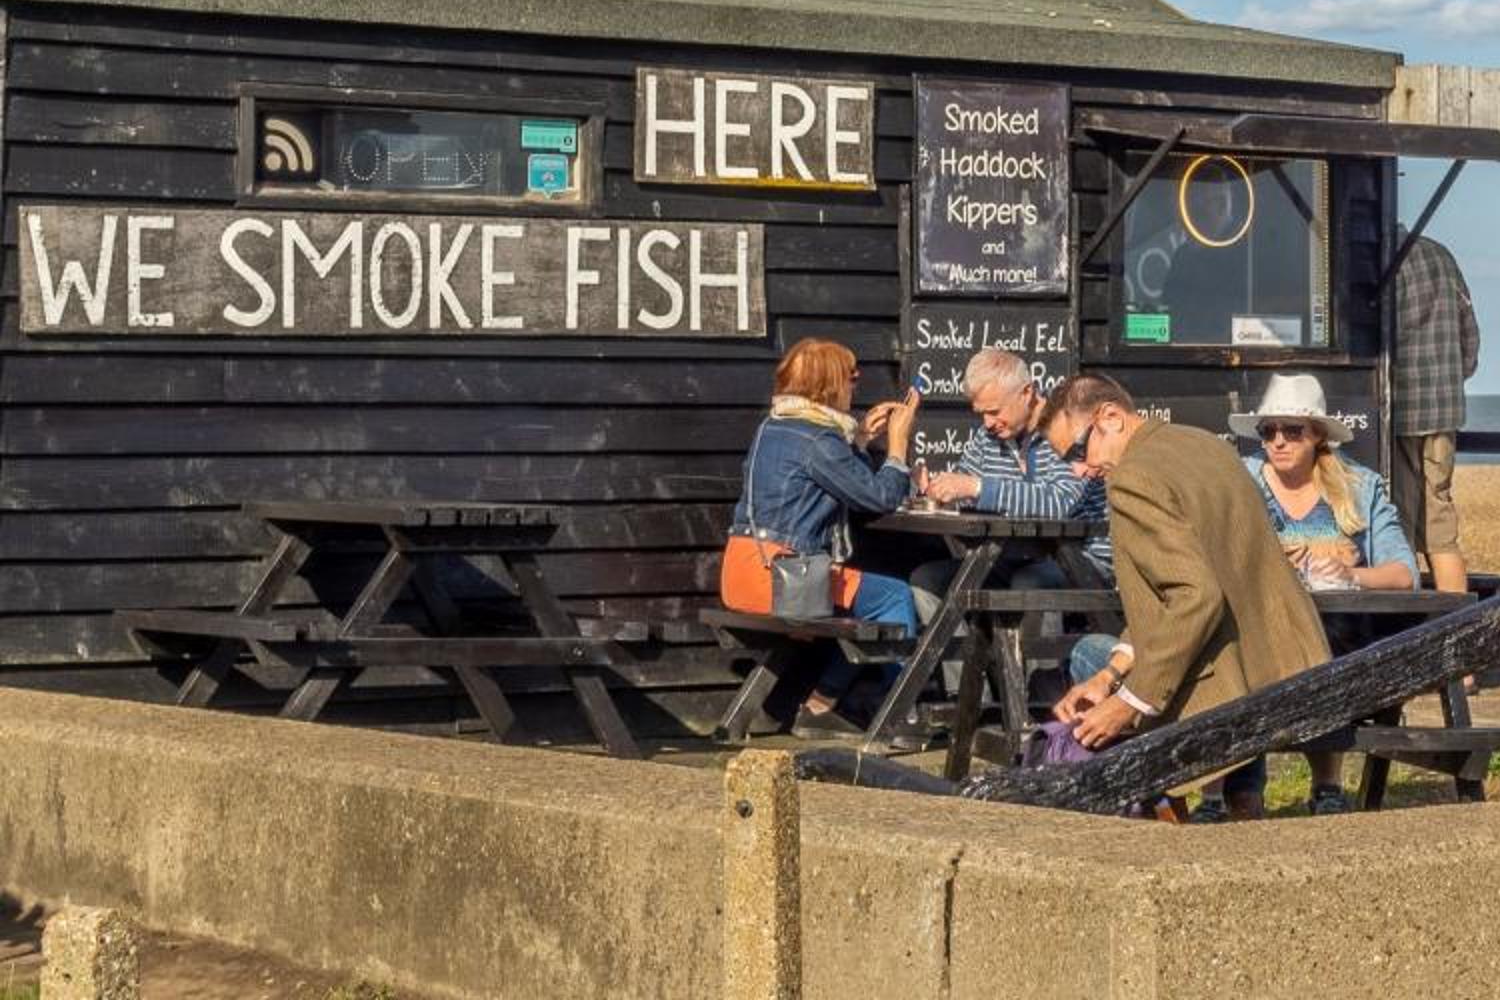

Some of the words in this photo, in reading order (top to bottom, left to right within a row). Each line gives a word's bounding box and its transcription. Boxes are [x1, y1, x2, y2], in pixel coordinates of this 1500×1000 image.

[644, 75, 870, 184] HERE
[944, 103, 1039, 135] Smoked
[940, 147, 1046, 179] Haddock
[947, 194, 1038, 231] Kippers
[981, 241, 1005, 255] and
[26, 214, 175, 328] WE
[220, 219, 525, 330] SMOKE
[566, 226, 749, 330] FISH
[993, 266, 1037, 284] more!
[981, 320, 1027, 351] Local
